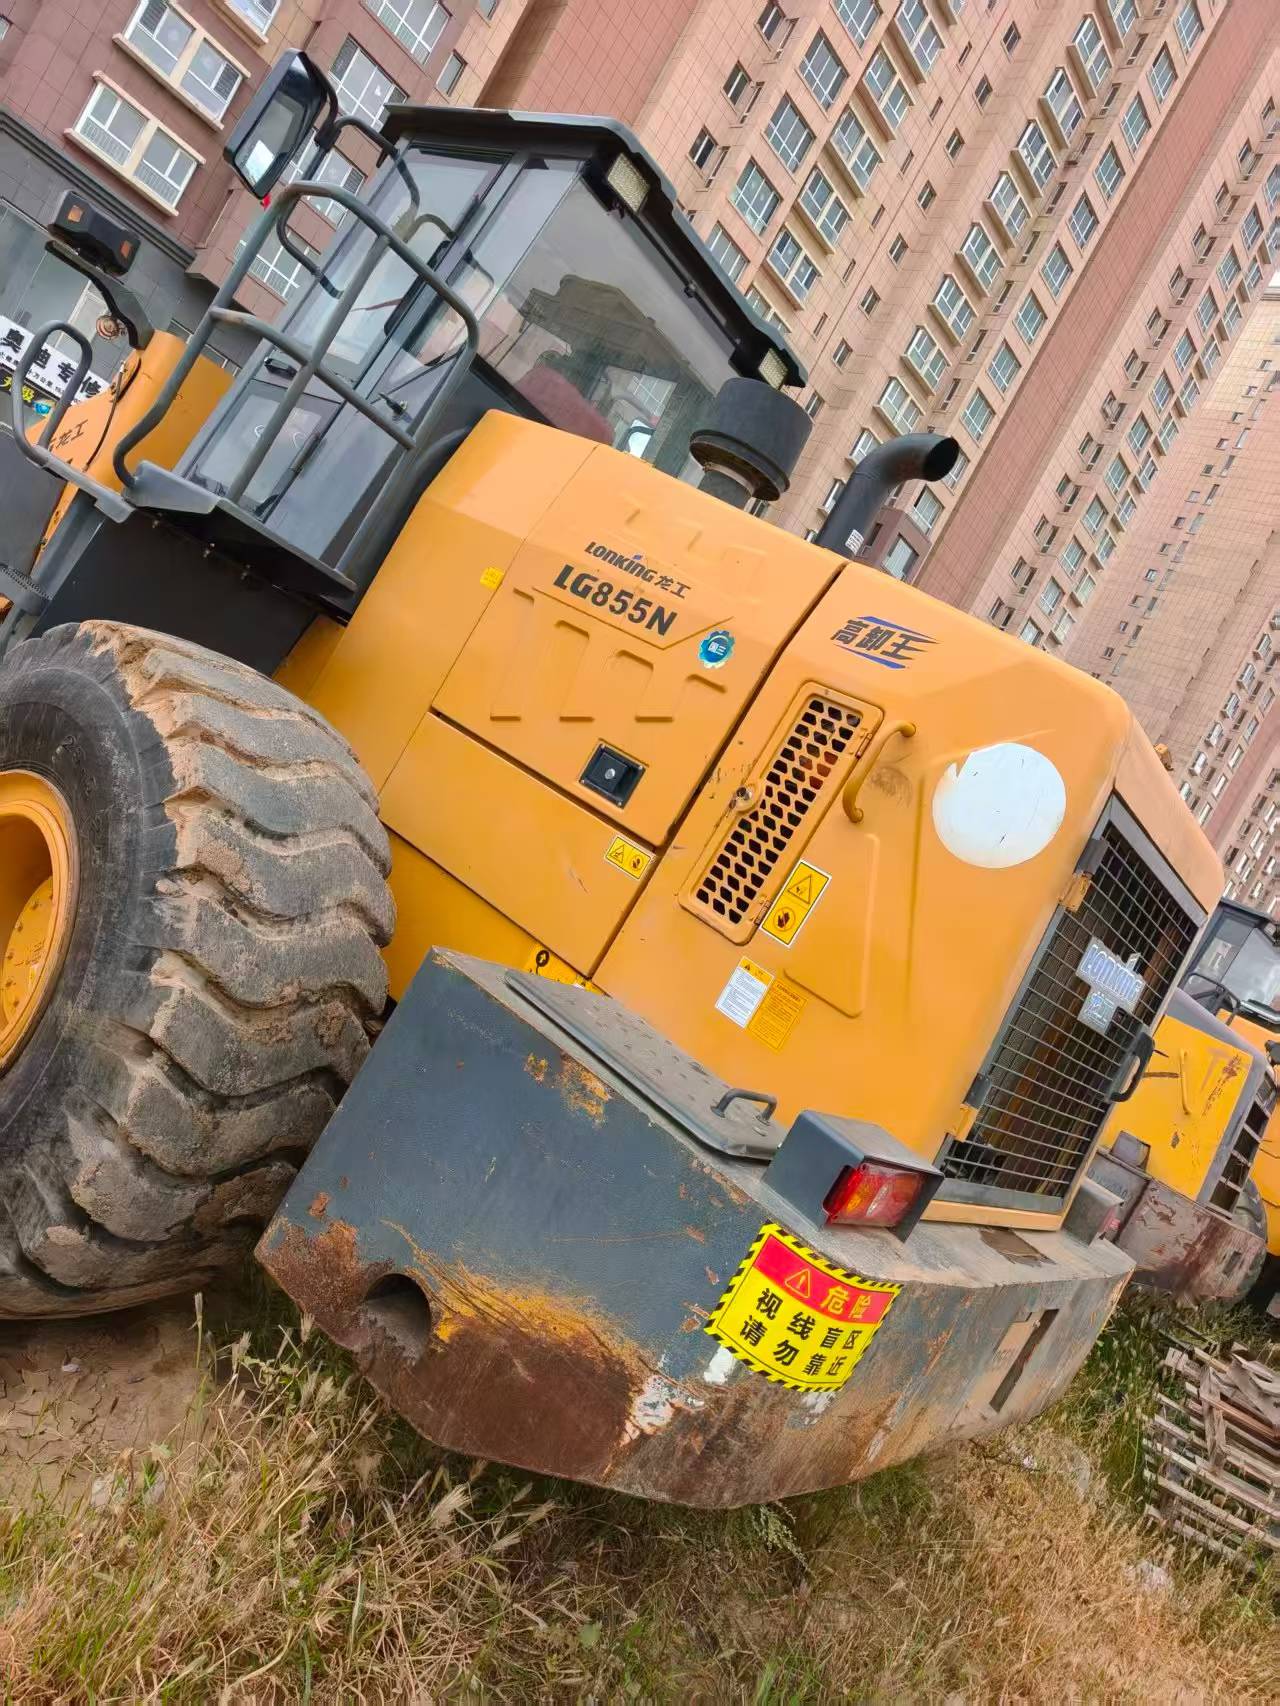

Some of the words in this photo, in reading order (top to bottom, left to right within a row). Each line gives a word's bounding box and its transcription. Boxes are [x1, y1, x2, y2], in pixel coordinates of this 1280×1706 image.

[553, 564, 678, 636] LG855N
[654, 575, 691, 599] 龙工
[755, 1287, 863, 1350] 视线盲区
[820, 1285, 872, 1319] 危险
[739, 1315, 848, 1376] 请勿靠近
